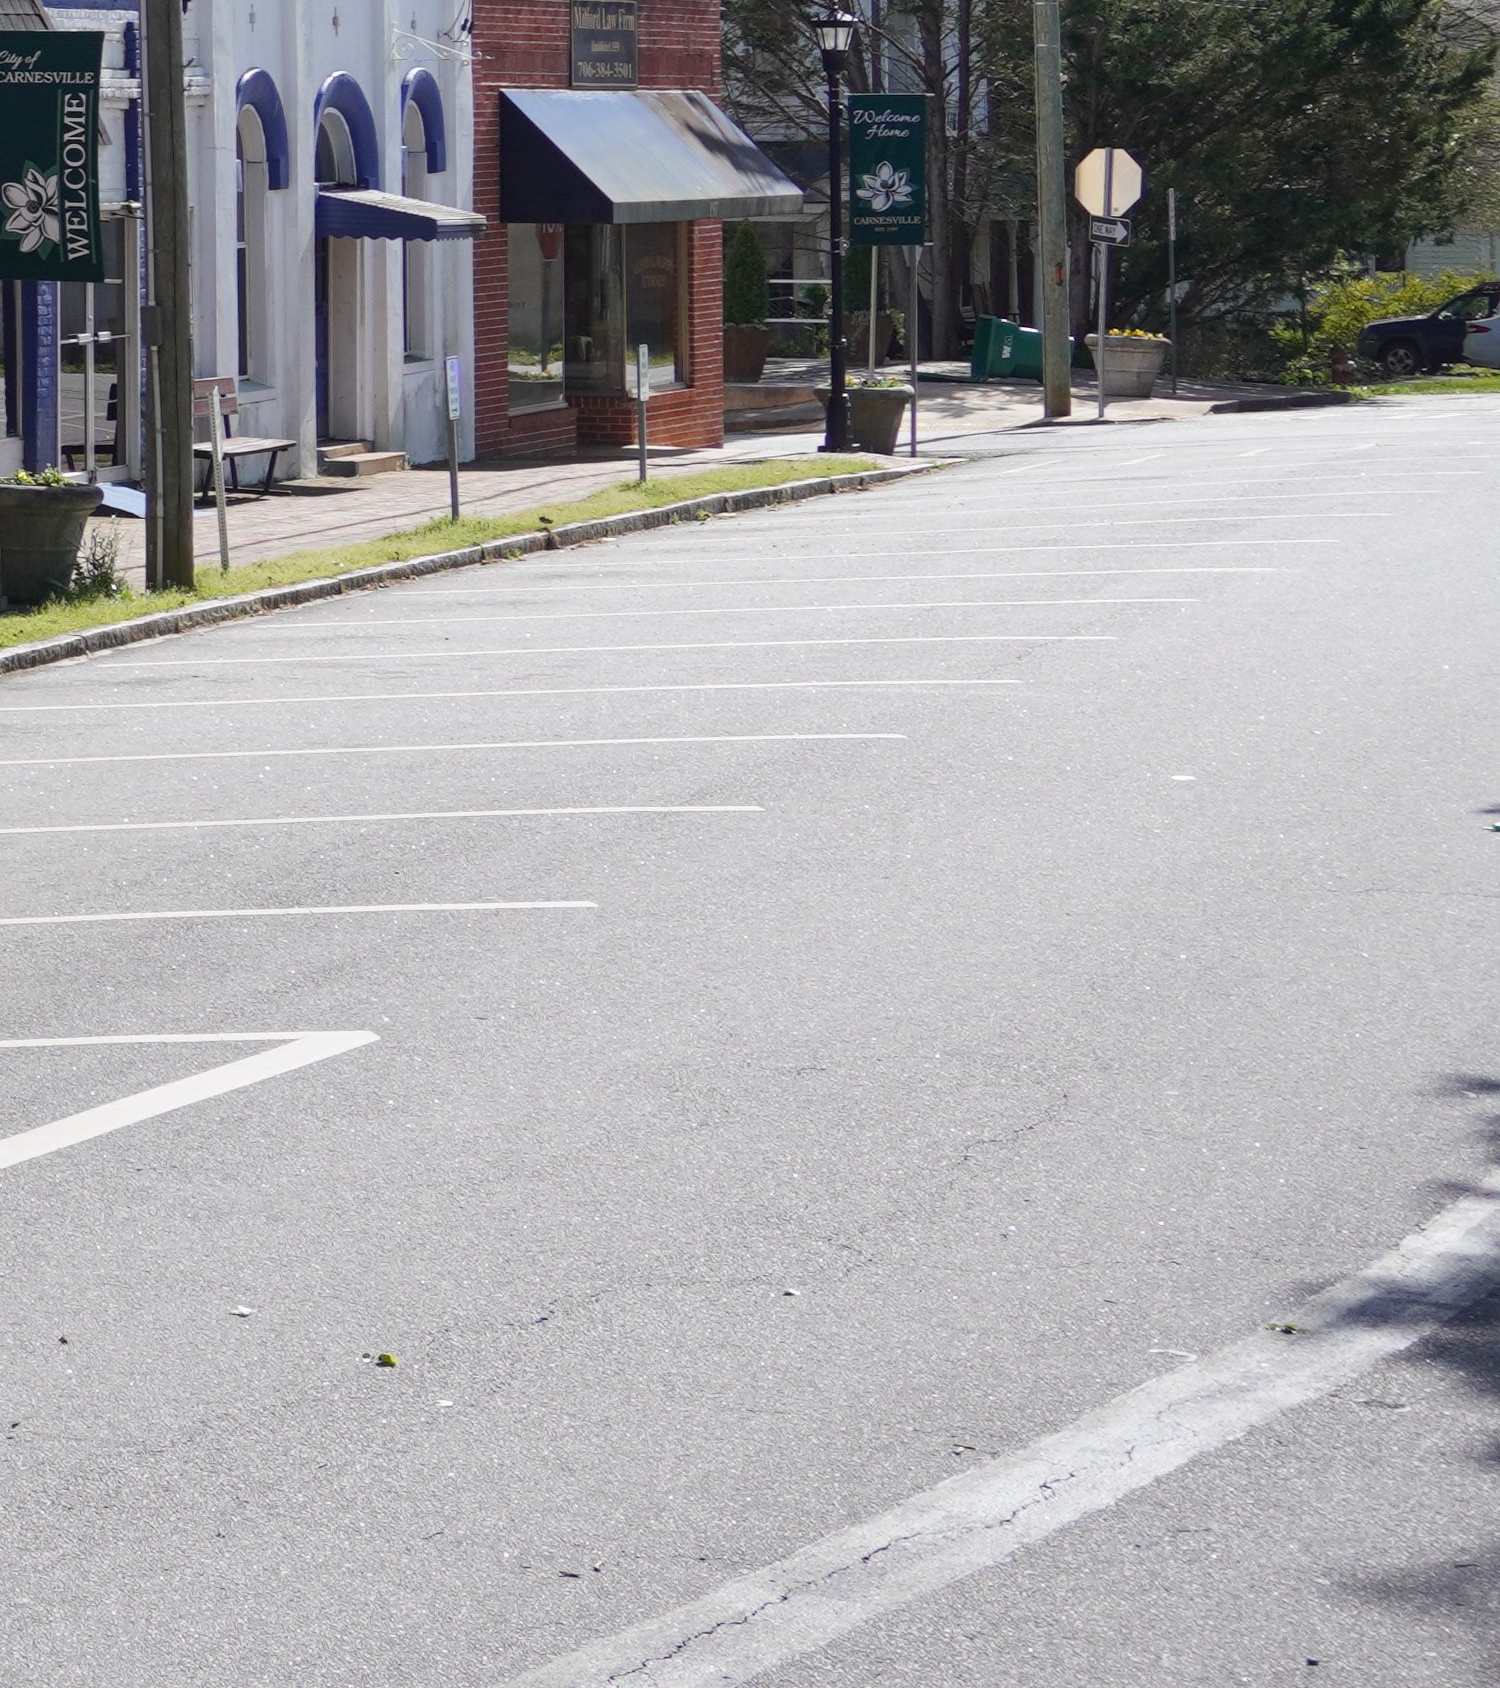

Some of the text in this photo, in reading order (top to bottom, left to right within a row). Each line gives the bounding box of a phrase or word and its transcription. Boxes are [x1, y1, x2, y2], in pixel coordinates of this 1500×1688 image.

[25, 50, 41, 69] of
[853, 109, 921, 125] Welcome
[865, 124, 910, 140] Home
[63, 92, 90, 261] WELCOME
[854, 216, 921, 226] CARNESVILLE
